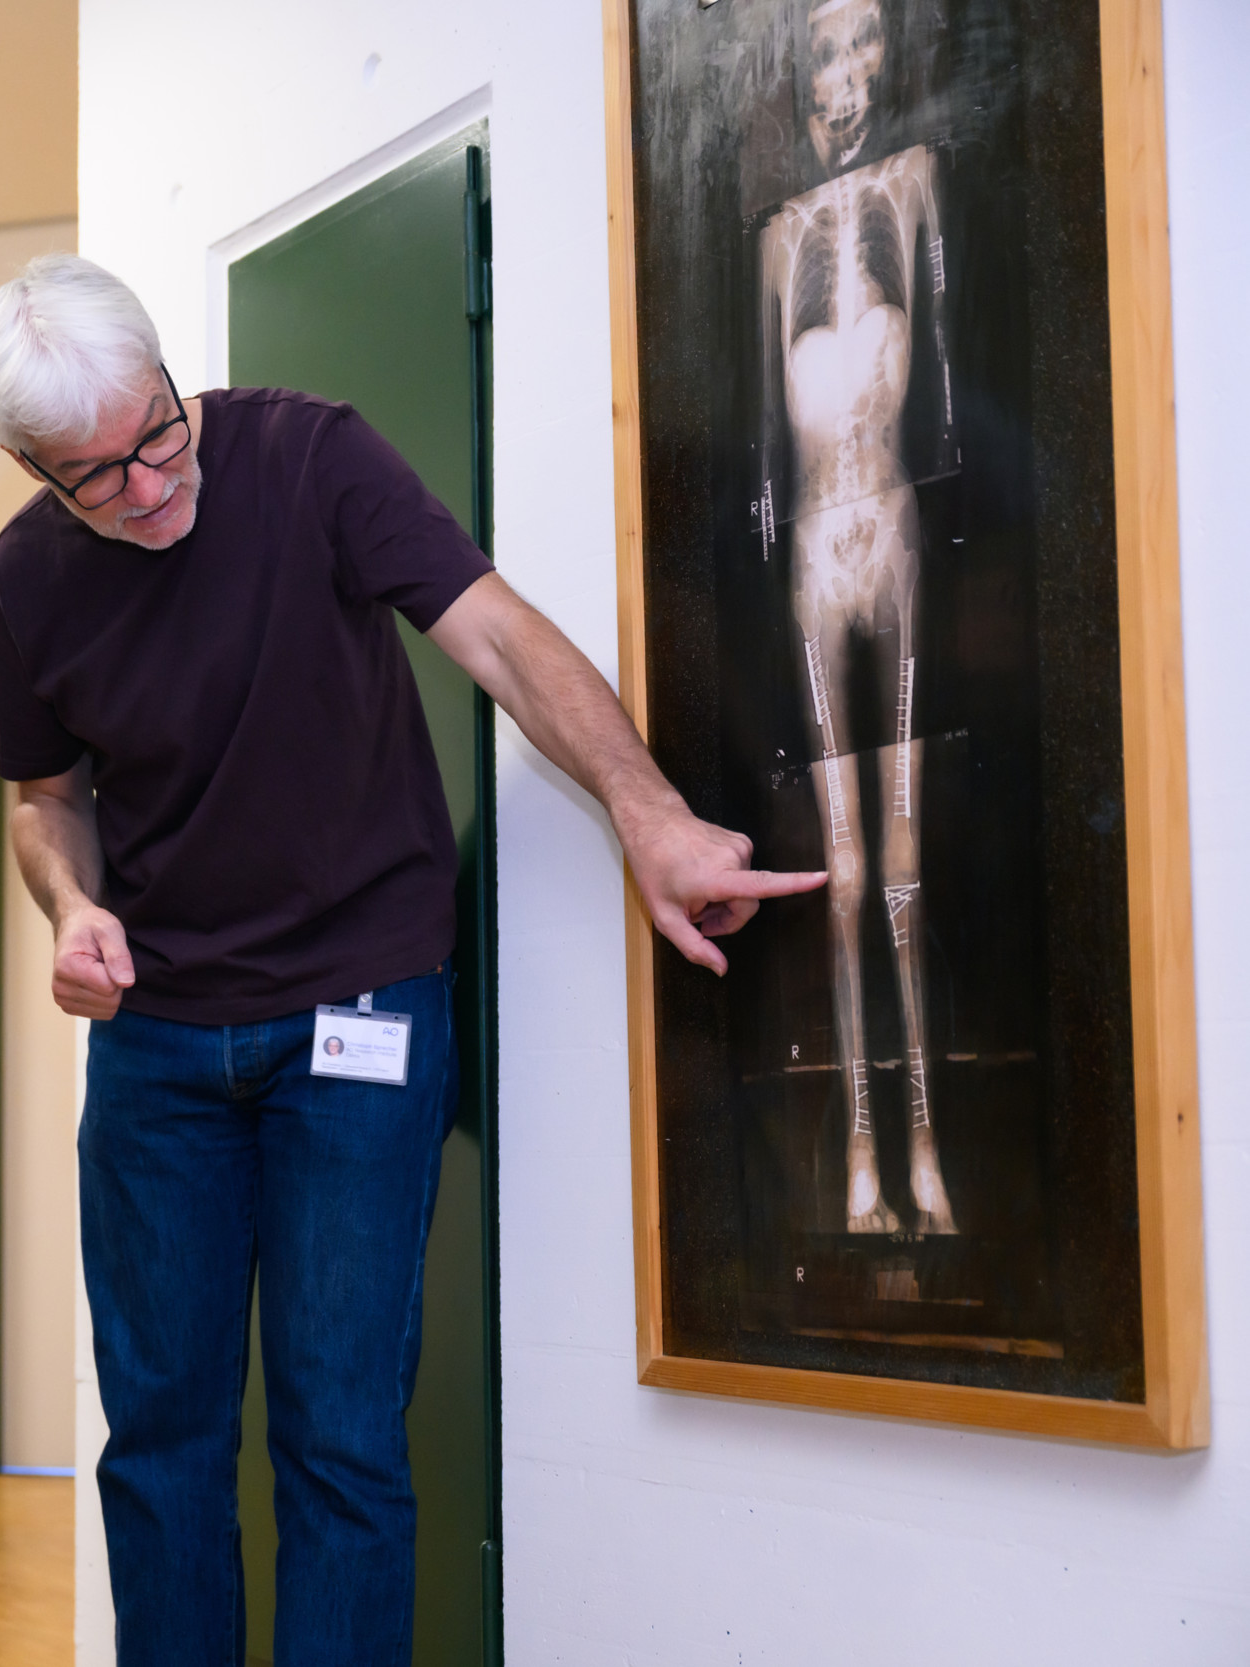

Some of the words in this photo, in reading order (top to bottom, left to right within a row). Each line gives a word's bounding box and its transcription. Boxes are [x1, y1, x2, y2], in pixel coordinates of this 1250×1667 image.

[750, 501, 759, 517] R
[791, 1045, 800, 1060] R
[796, 1267, 805, 1283] R
